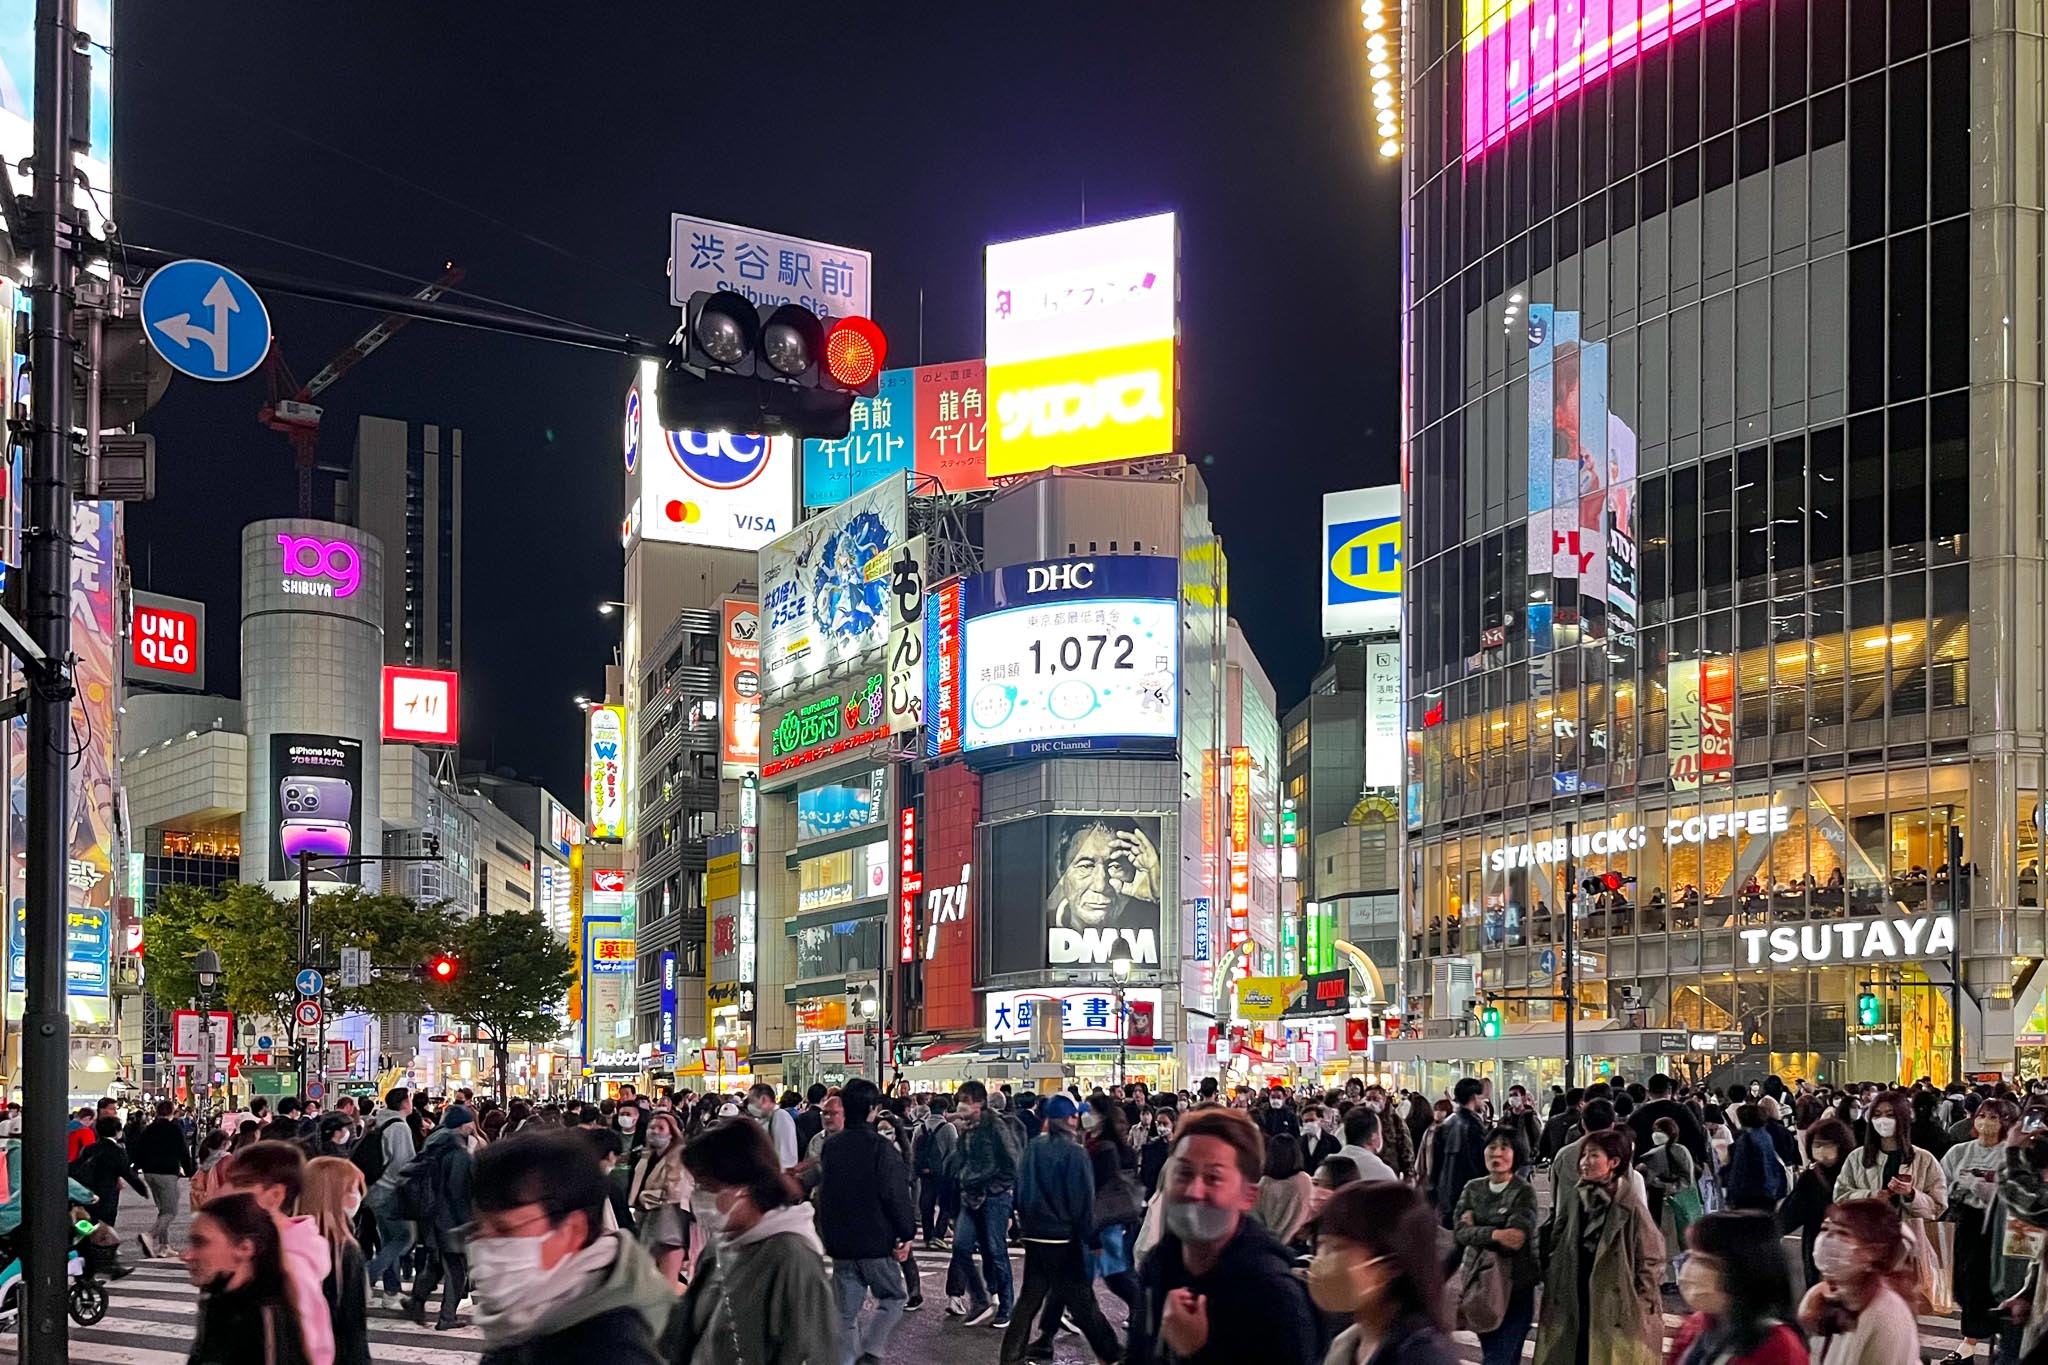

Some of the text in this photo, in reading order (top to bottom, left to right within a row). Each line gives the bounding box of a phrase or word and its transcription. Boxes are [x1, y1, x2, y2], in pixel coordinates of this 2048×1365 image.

[690, 231, 854, 299] 渋谷駅前
[734, 513, 776, 533] VISA
[277, 533, 361, 599] 109
[1026, 562, 1094, 594] DHC
[281, 579, 332, 597] SHIBUYA
[141, 613, 185, 642] UNI
[771, 595, 806, 630] ようこそ
[140, 638, 189, 665] QLO
[892, 545, 923, 723] もんじゃ
[1028, 634, 1135, 675] 1,072
[800, 706, 839, 747] 西村
[295, 746, 345, 759] iPhone 14 Pro
[1031, 739, 1091, 753] DHC Channel
[1490, 805, 1790, 871] STARBUCKS COFFEE
[925, 863, 971, 961] クスリ
[1048, 927, 1158, 964] DMM
[1739, 916, 1955, 964] TSUTAYA
